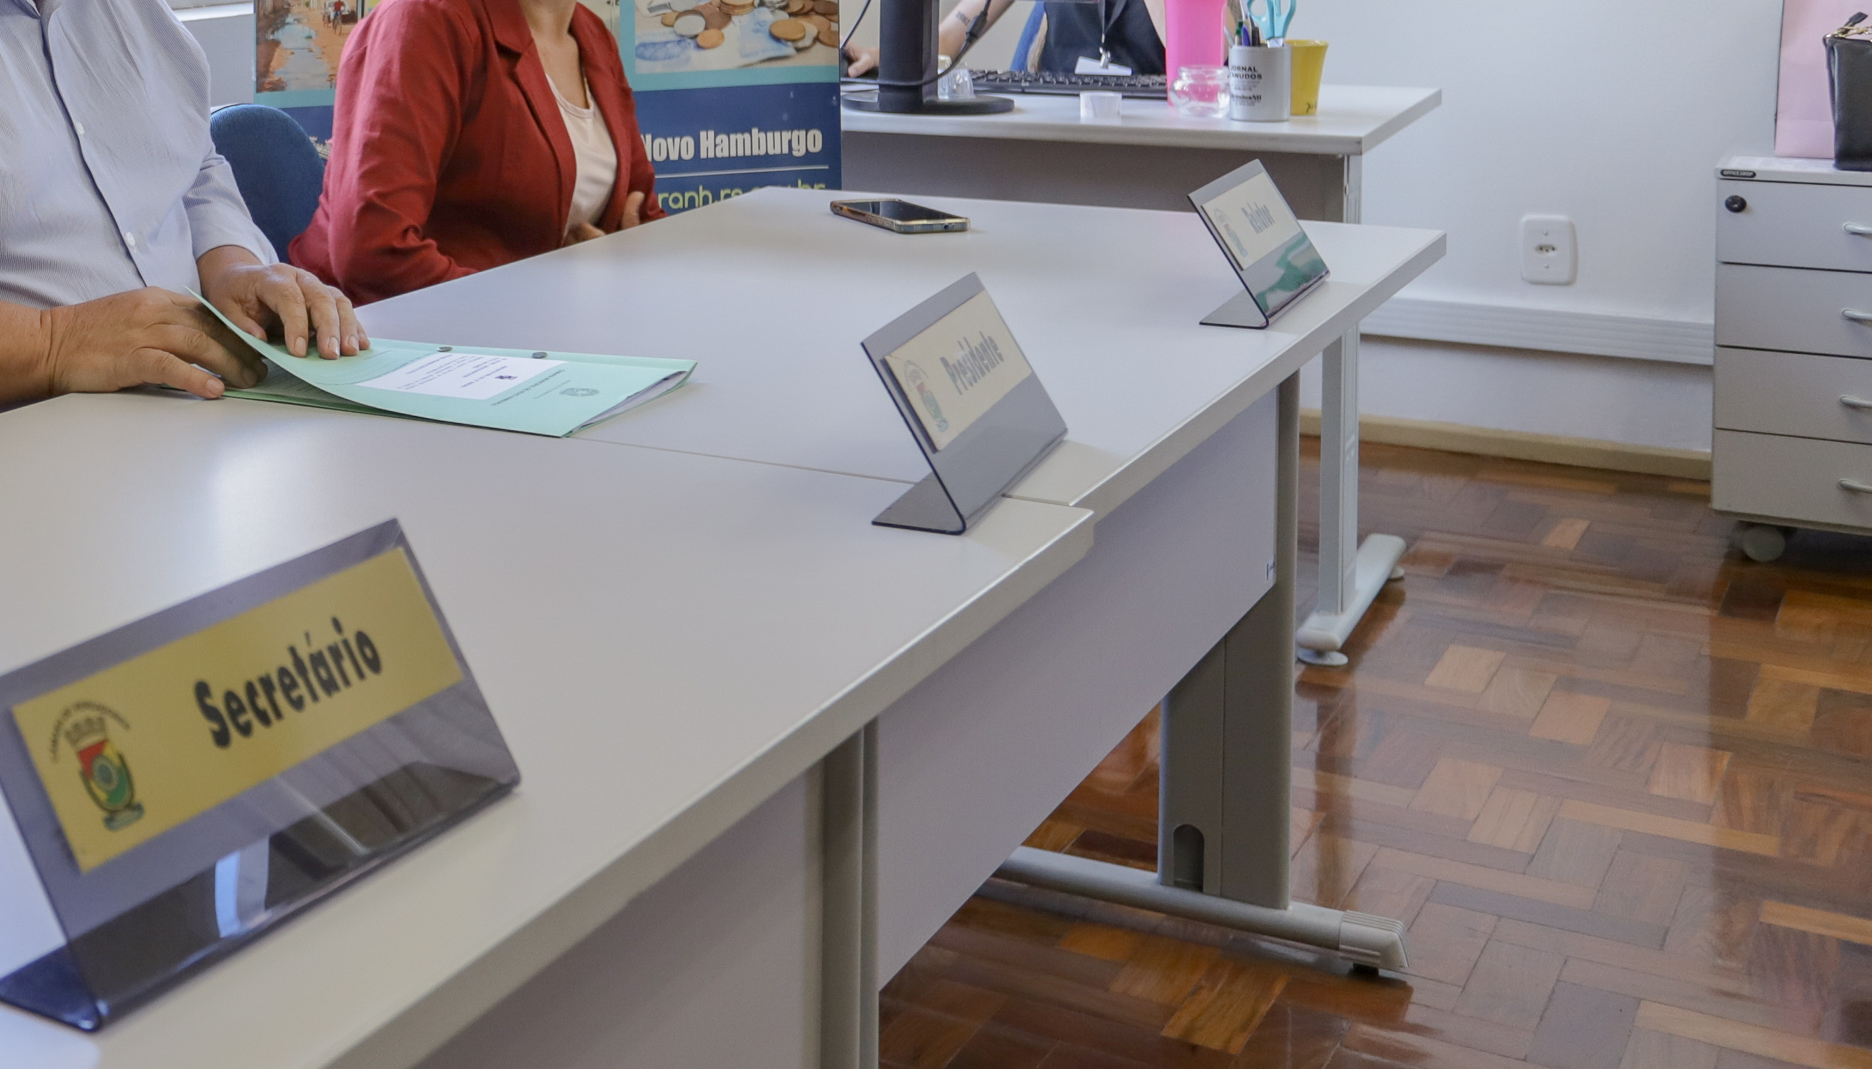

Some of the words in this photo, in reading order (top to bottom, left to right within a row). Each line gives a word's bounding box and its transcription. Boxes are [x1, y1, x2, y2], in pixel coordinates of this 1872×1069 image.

[641, 133, 695, 162] Novo
[699, 127, 823, 158] Hamburgo
[940, 330, 1004, 396] Presidente
[194, 616, 383, 749] Secretário
